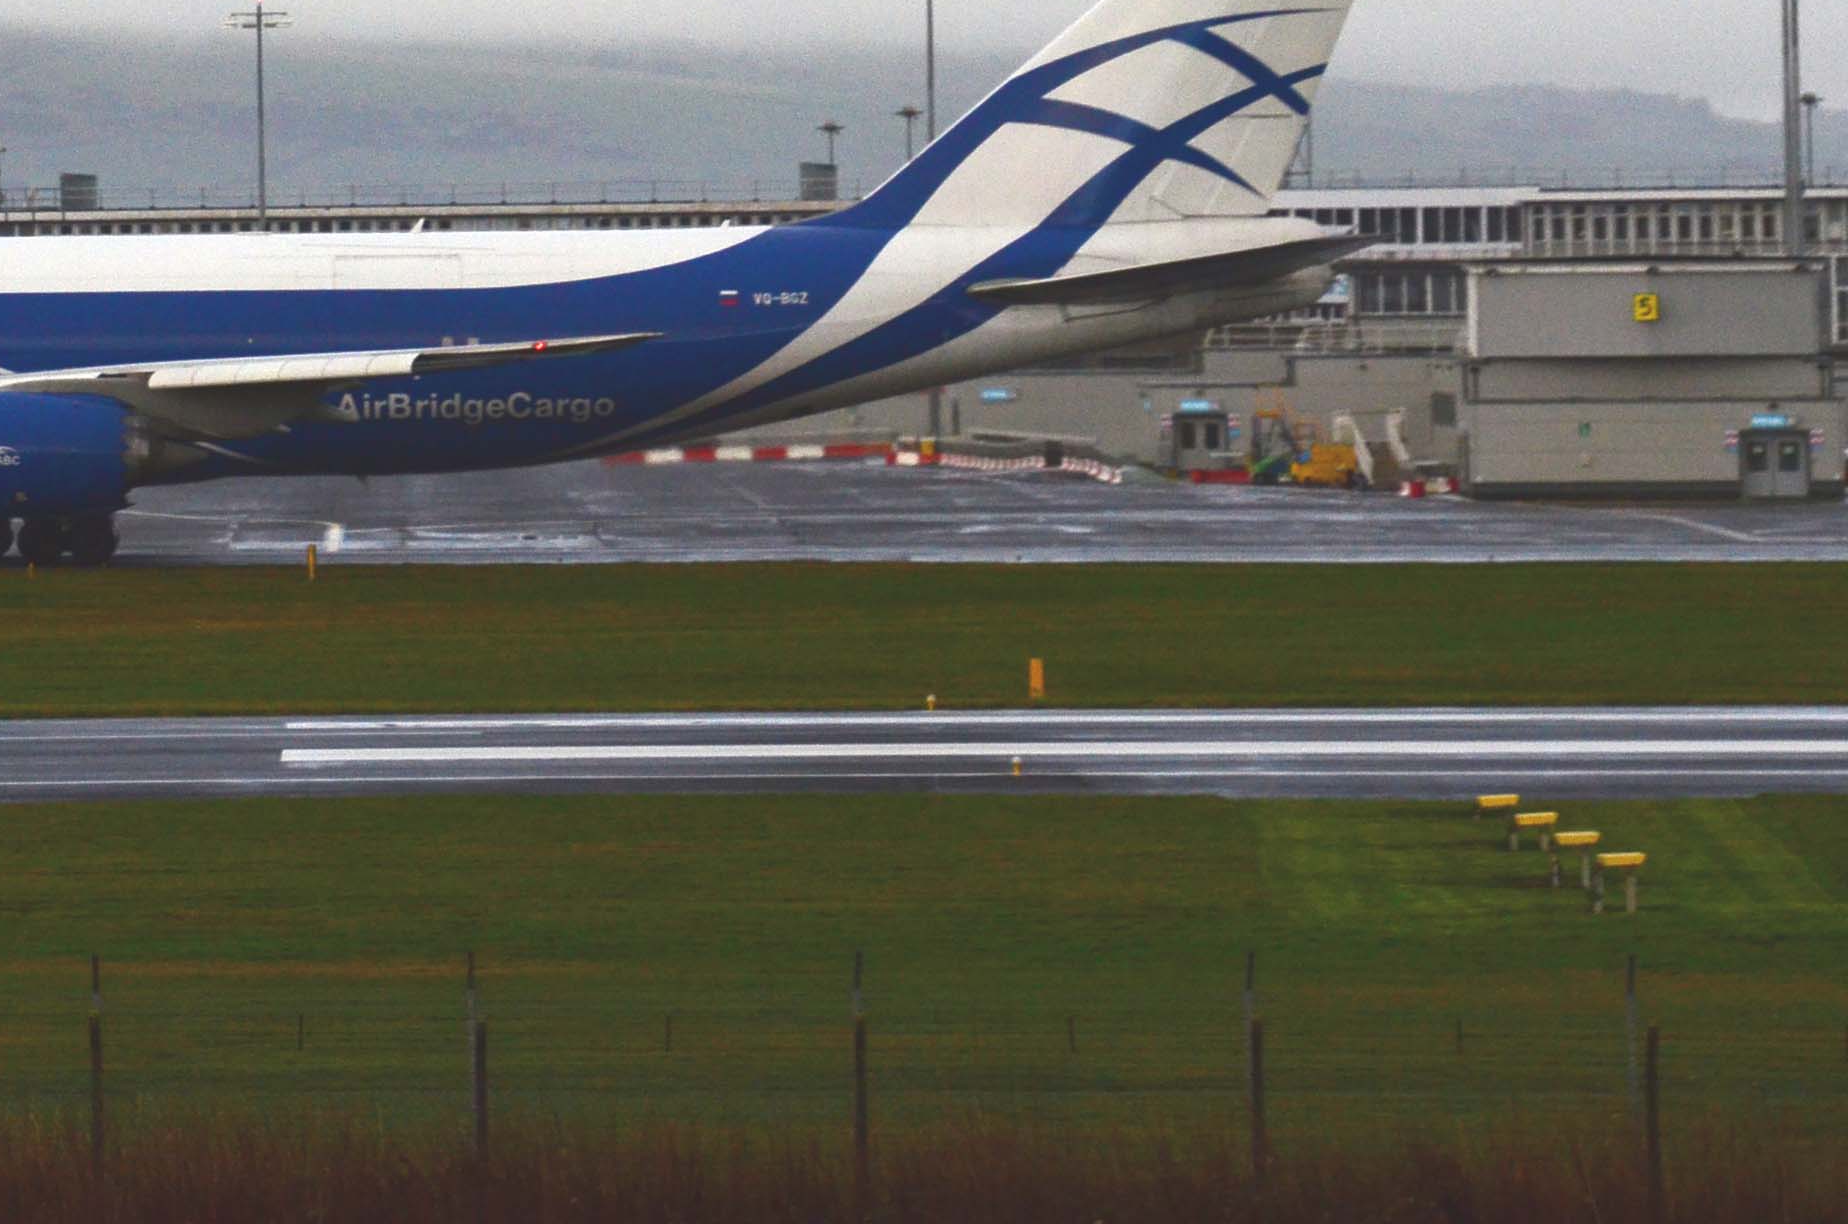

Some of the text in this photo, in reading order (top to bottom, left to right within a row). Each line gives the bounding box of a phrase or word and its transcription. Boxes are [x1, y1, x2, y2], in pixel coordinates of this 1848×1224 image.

[753, 291, 809, 305] VQ-BGZ
[1639, 296, 1653, 316] 5
[337, 391, 616, 424] AirBridgeCargo
